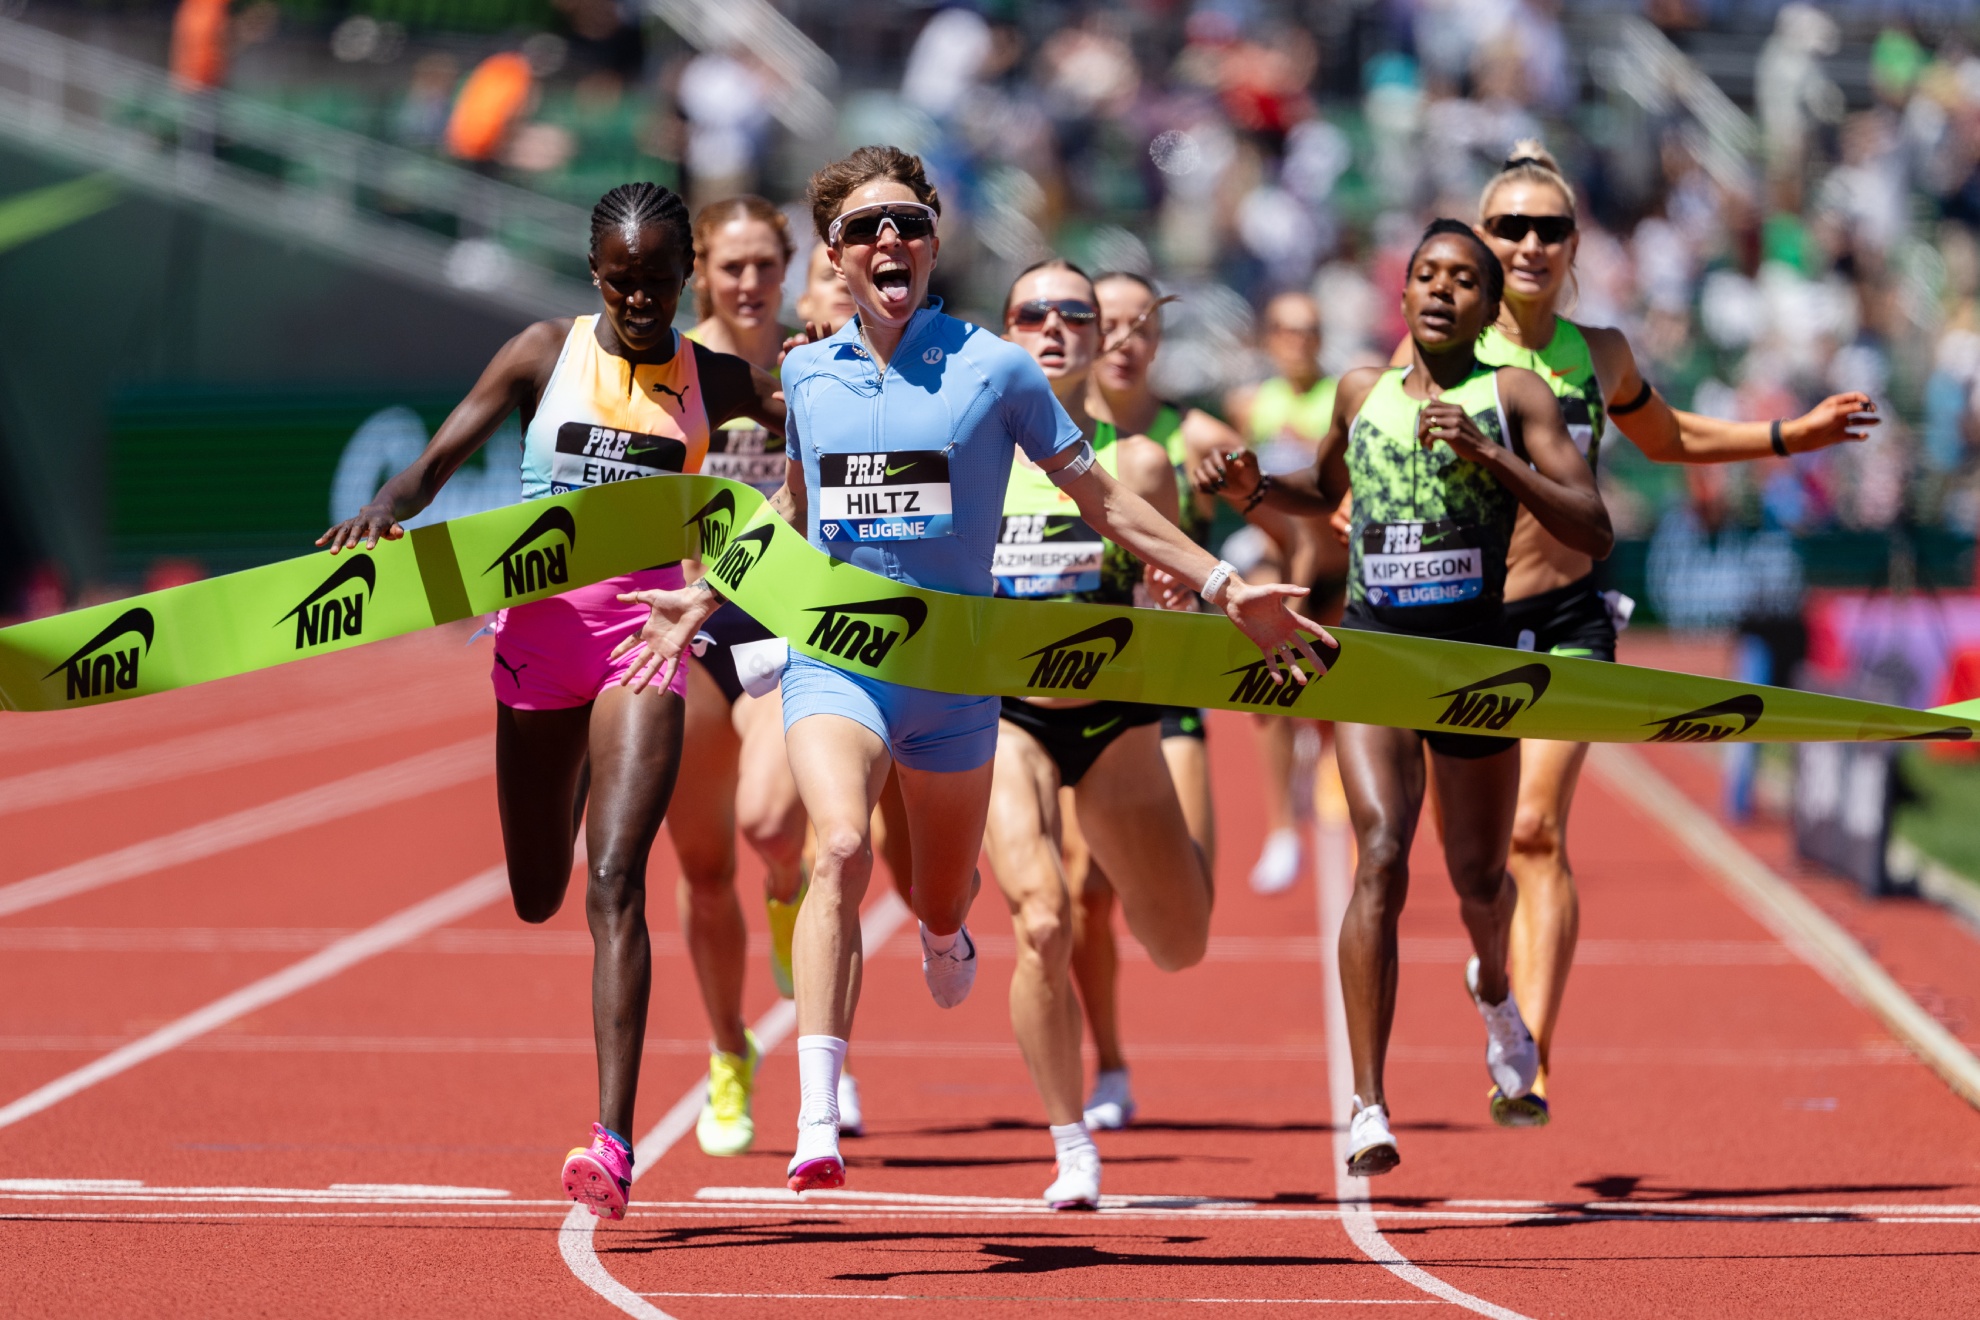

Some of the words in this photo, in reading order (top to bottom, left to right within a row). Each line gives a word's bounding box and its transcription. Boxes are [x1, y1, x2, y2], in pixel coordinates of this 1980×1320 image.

[582, 427, 631, 460] PRE
[582, 463, 652, 485] EW
[710, 460, 786, 478] MACK
[844, 454, 887, 485] PRE
[847, 490, 920, 515] HILTZ
[858, 521, 925, 539] EUGENE
[1002, 514, 1047, 544] PRE
[1382, 524, 1423, 554] PRE
[503, 543, 568, 598] RUN
[712, 541, 754, 592] RUN
[994, 551, 1096, 568] AZIMIERSKA
[1372, 557, 1472, 579] KIPYEGON
[1015, 576, 1076, 594] EUGENE
[1397, 585, 1460, 604] EUGENE
[296, 592, 363, 649] RUN
[806, 611, 900, 668] RUN
[66, 647, 139, 700] RUN
[1026, 649, 1108, 690] RUN
[1228, 667, 1314, 708] RUN
[1435, 692, 1525, 730] RUN
